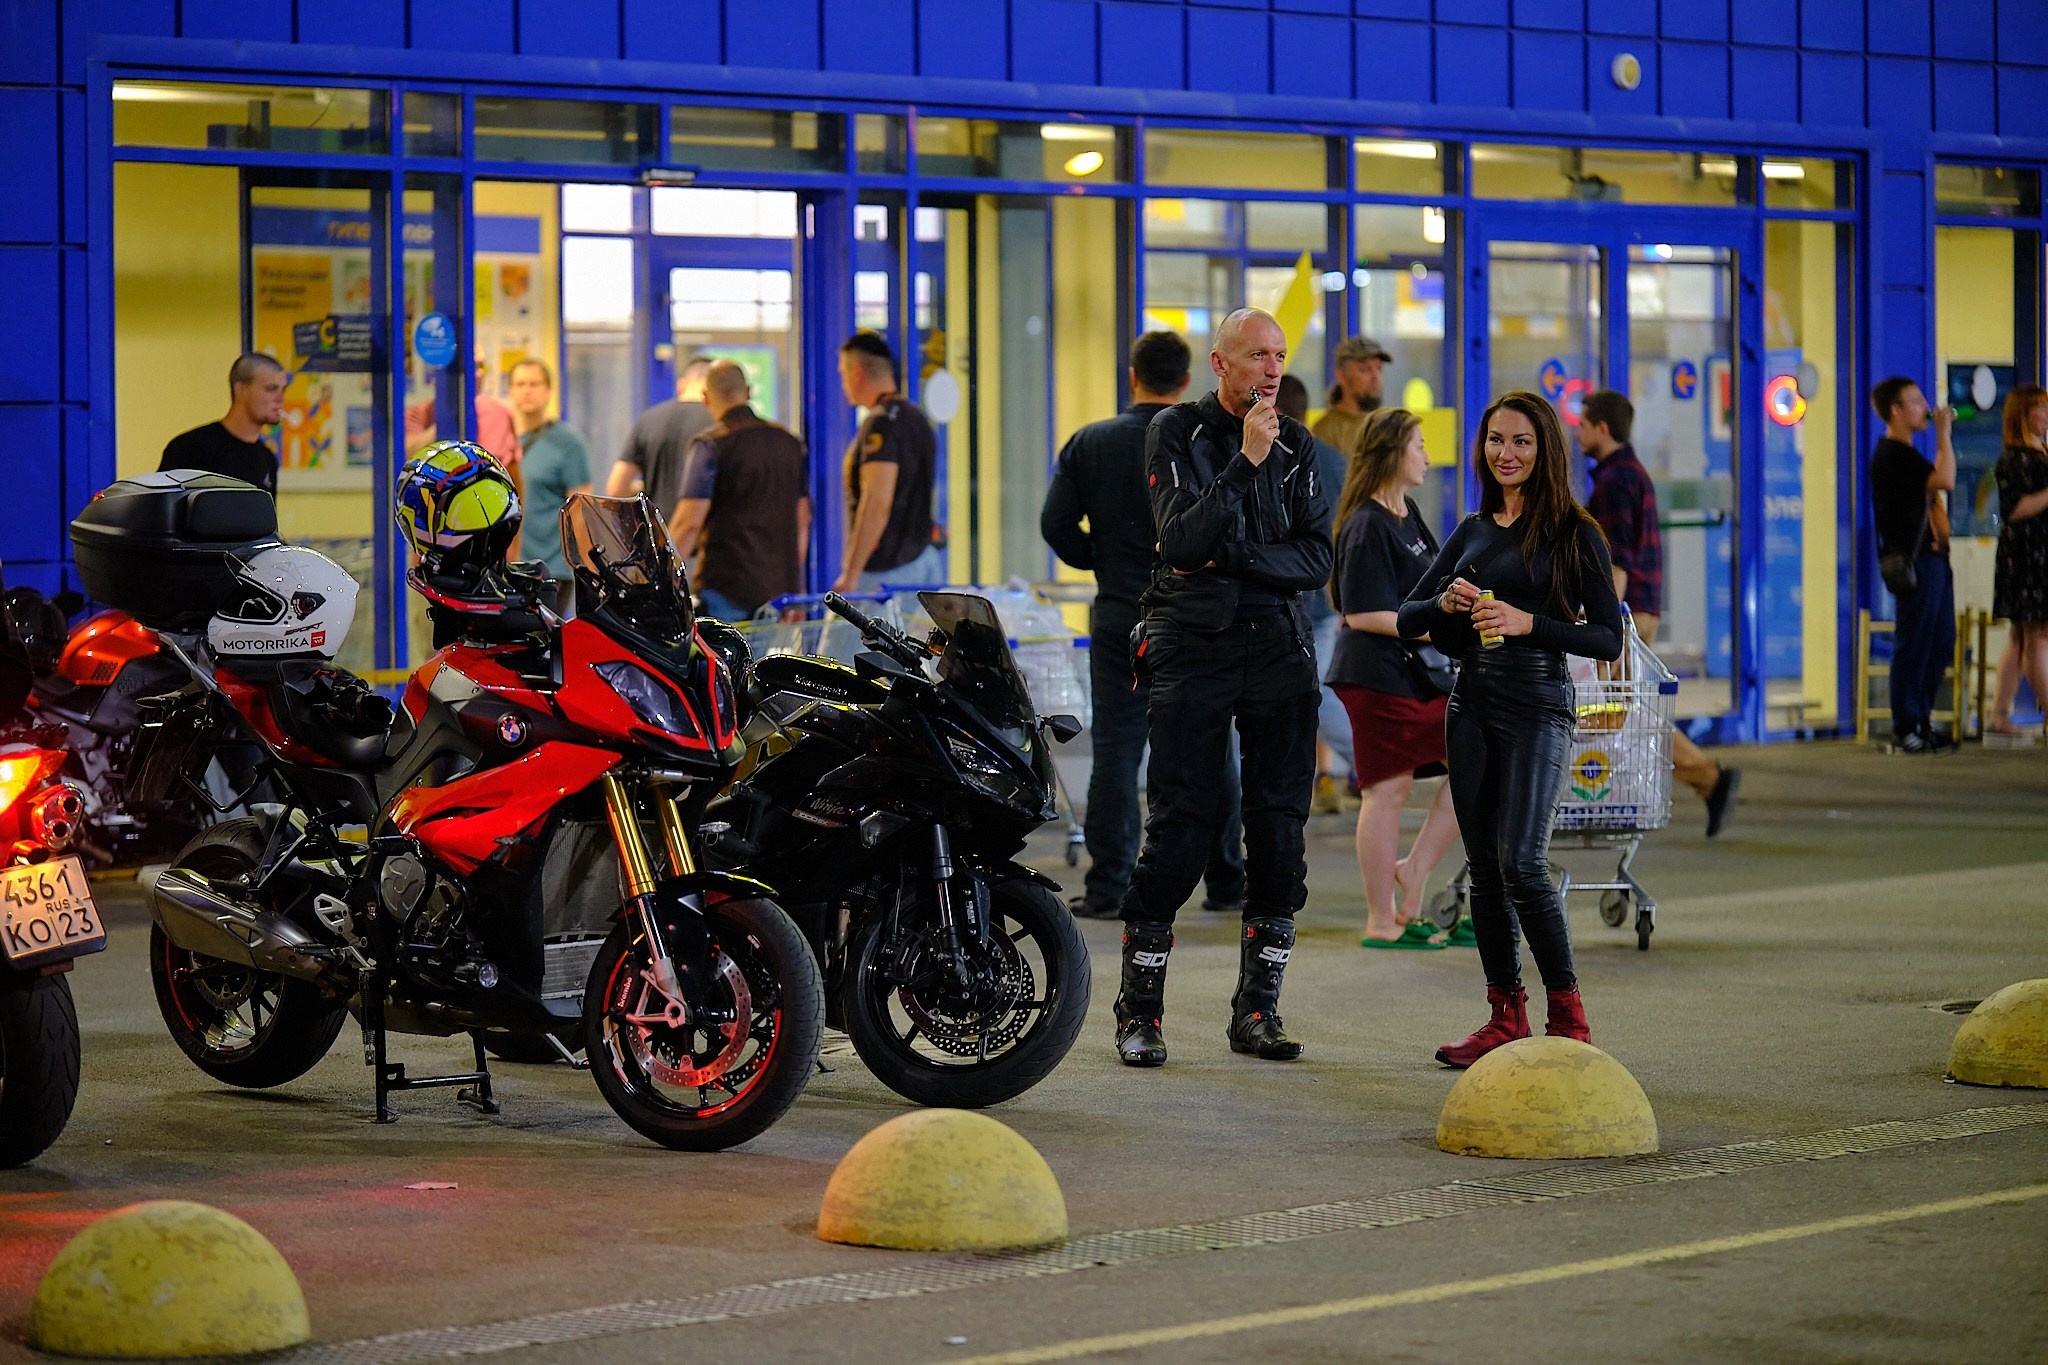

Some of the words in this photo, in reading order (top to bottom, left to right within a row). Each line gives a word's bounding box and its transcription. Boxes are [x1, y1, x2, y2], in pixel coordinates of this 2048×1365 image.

[222, 637, 309, 650] MOTORRIKA
[809, 796, 846, 815] Ninja
[5, 867, 72, 907] 4361
[45, 899, 70, 914] RUS
[58, 907, 94, 938] 23
[617, 976, 633, 1008] brembo
